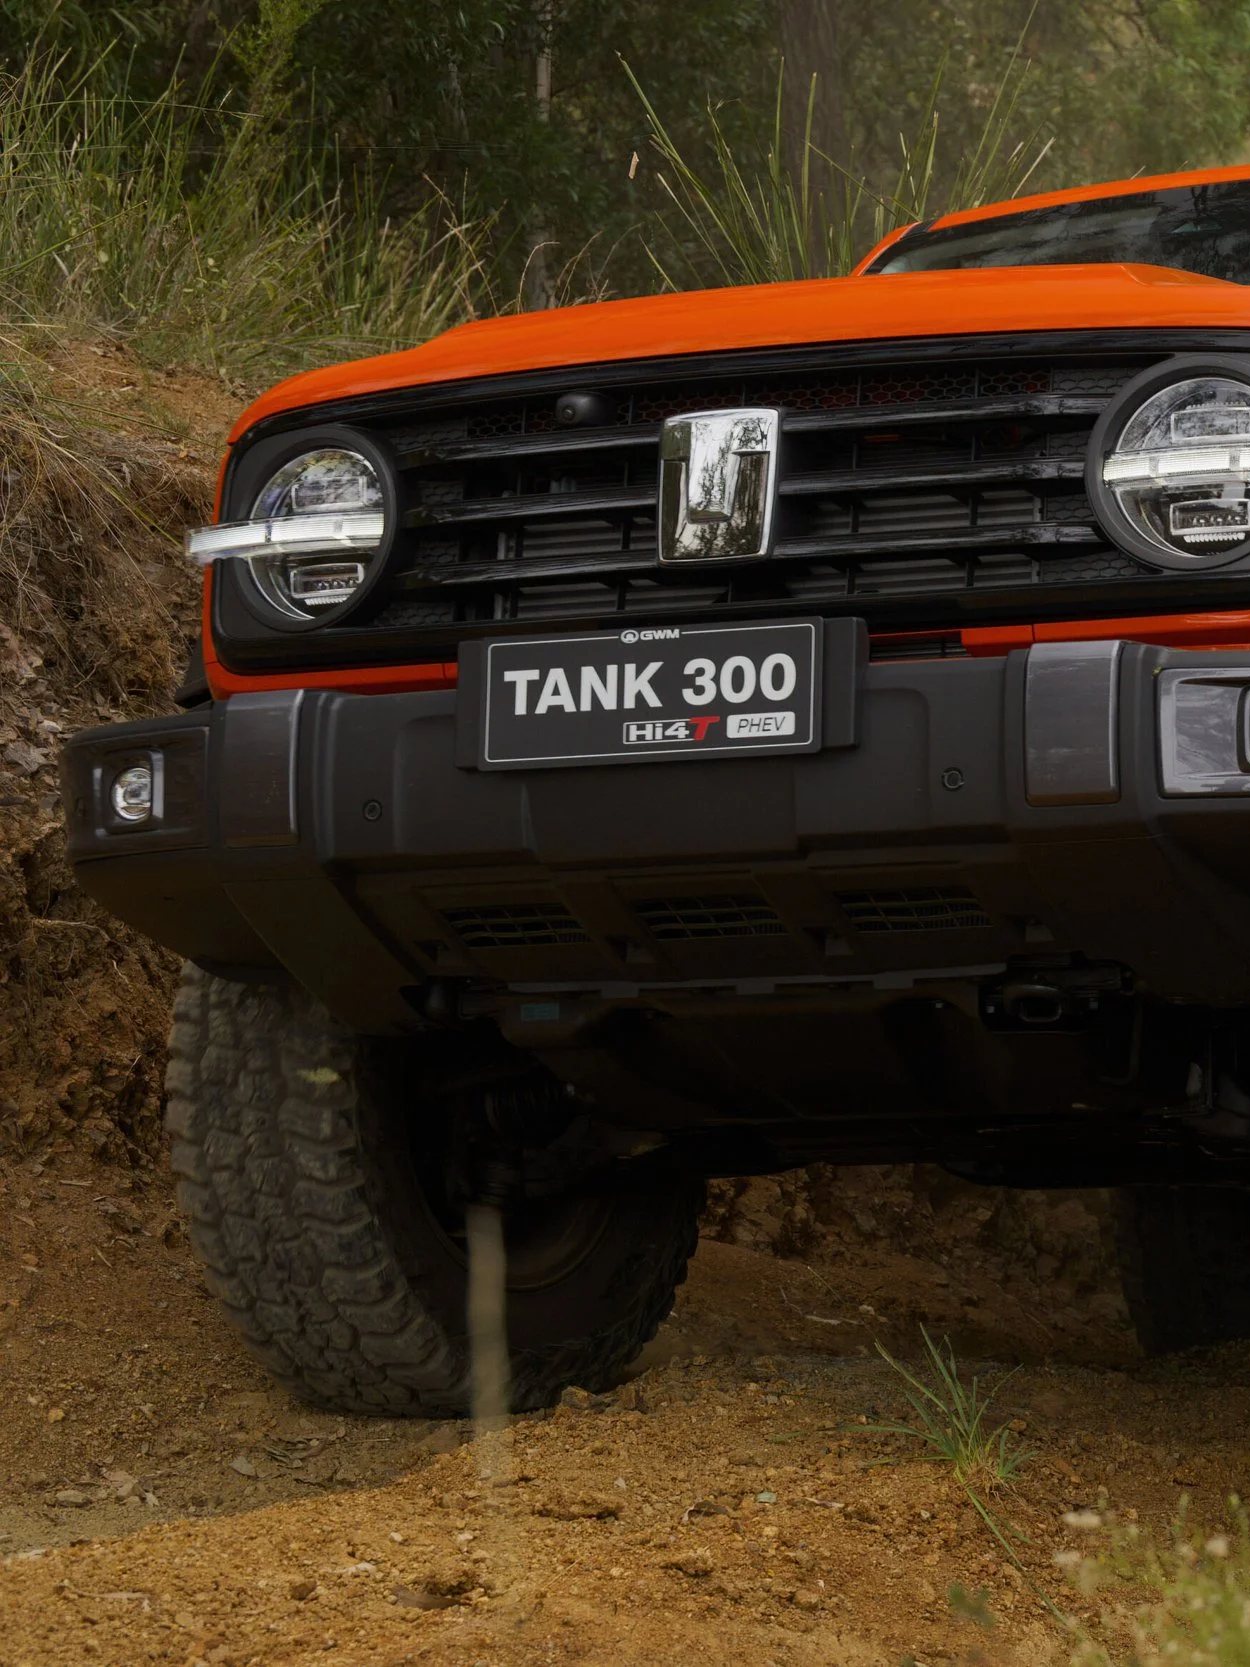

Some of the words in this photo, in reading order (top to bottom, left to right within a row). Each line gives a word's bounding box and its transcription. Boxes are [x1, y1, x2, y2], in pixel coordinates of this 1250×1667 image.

[640, 628, 680, 640] GWM
[503, 661, 664, 716] TANK
[681, 652, 798, 706] 300
[737, 716, 786, 733] PHEV
